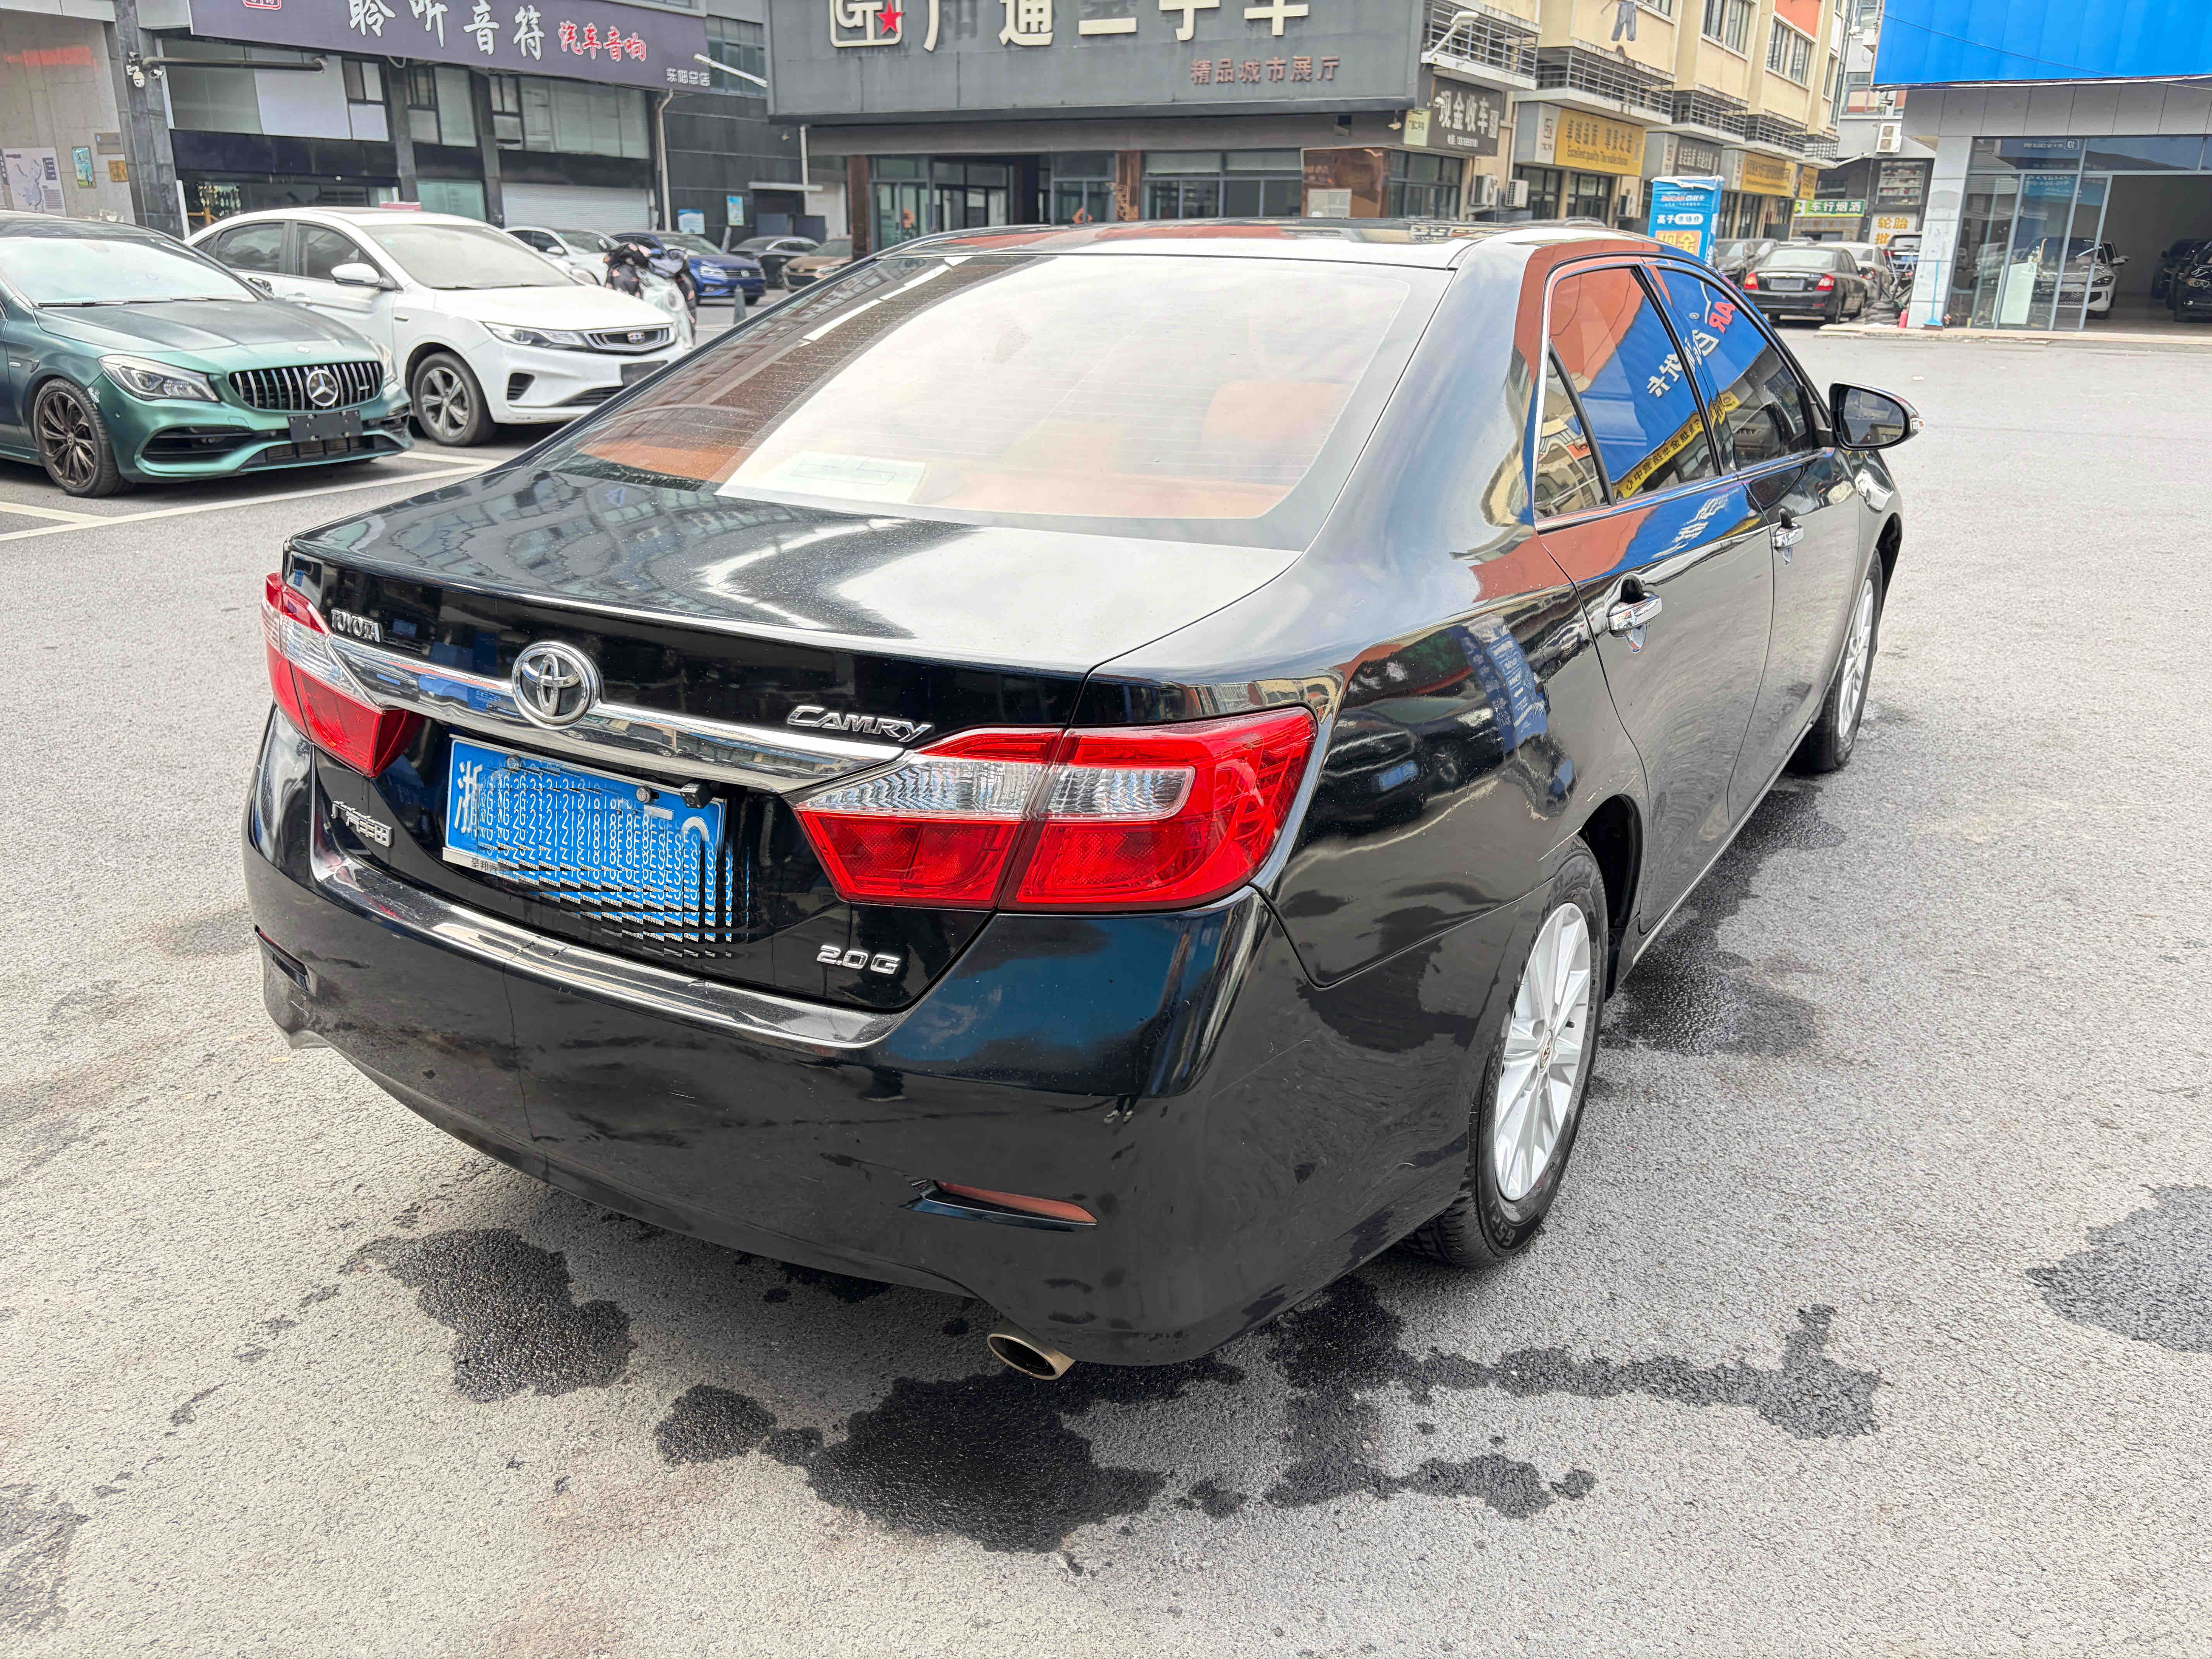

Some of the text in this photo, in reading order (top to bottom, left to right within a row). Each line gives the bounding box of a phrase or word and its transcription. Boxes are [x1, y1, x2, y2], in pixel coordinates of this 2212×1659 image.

[349, 0, 545, 60] 聆听音符
[558, 20, 647, 62] 汽车音响
[1190, 55, 1340, 84] 精品城市展厅
[1810, 201, 1863, 213] 车行烟酒
[1877, 216, 1909, 230] 轮胎
[330, 607, 380, 643] TOYOTA
[787, 705, 933, 743] CAMRY
